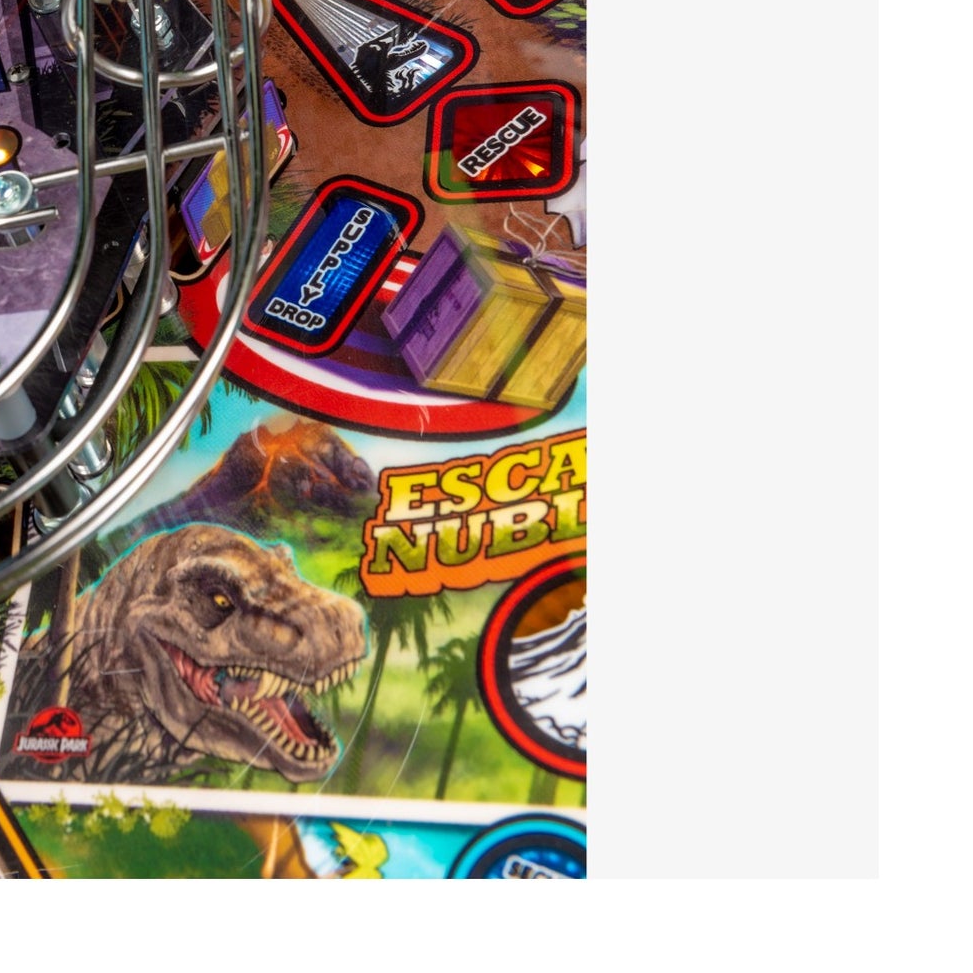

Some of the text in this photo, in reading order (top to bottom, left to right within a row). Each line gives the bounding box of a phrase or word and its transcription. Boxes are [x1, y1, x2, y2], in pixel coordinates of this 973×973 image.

[458, 107, 546, 176] RESCUE
[299, 208, 373, 306] SUPPLY
[266, 298, 325, 329] DROP
[17, 736, 88, 753] JURASSIC PARK
